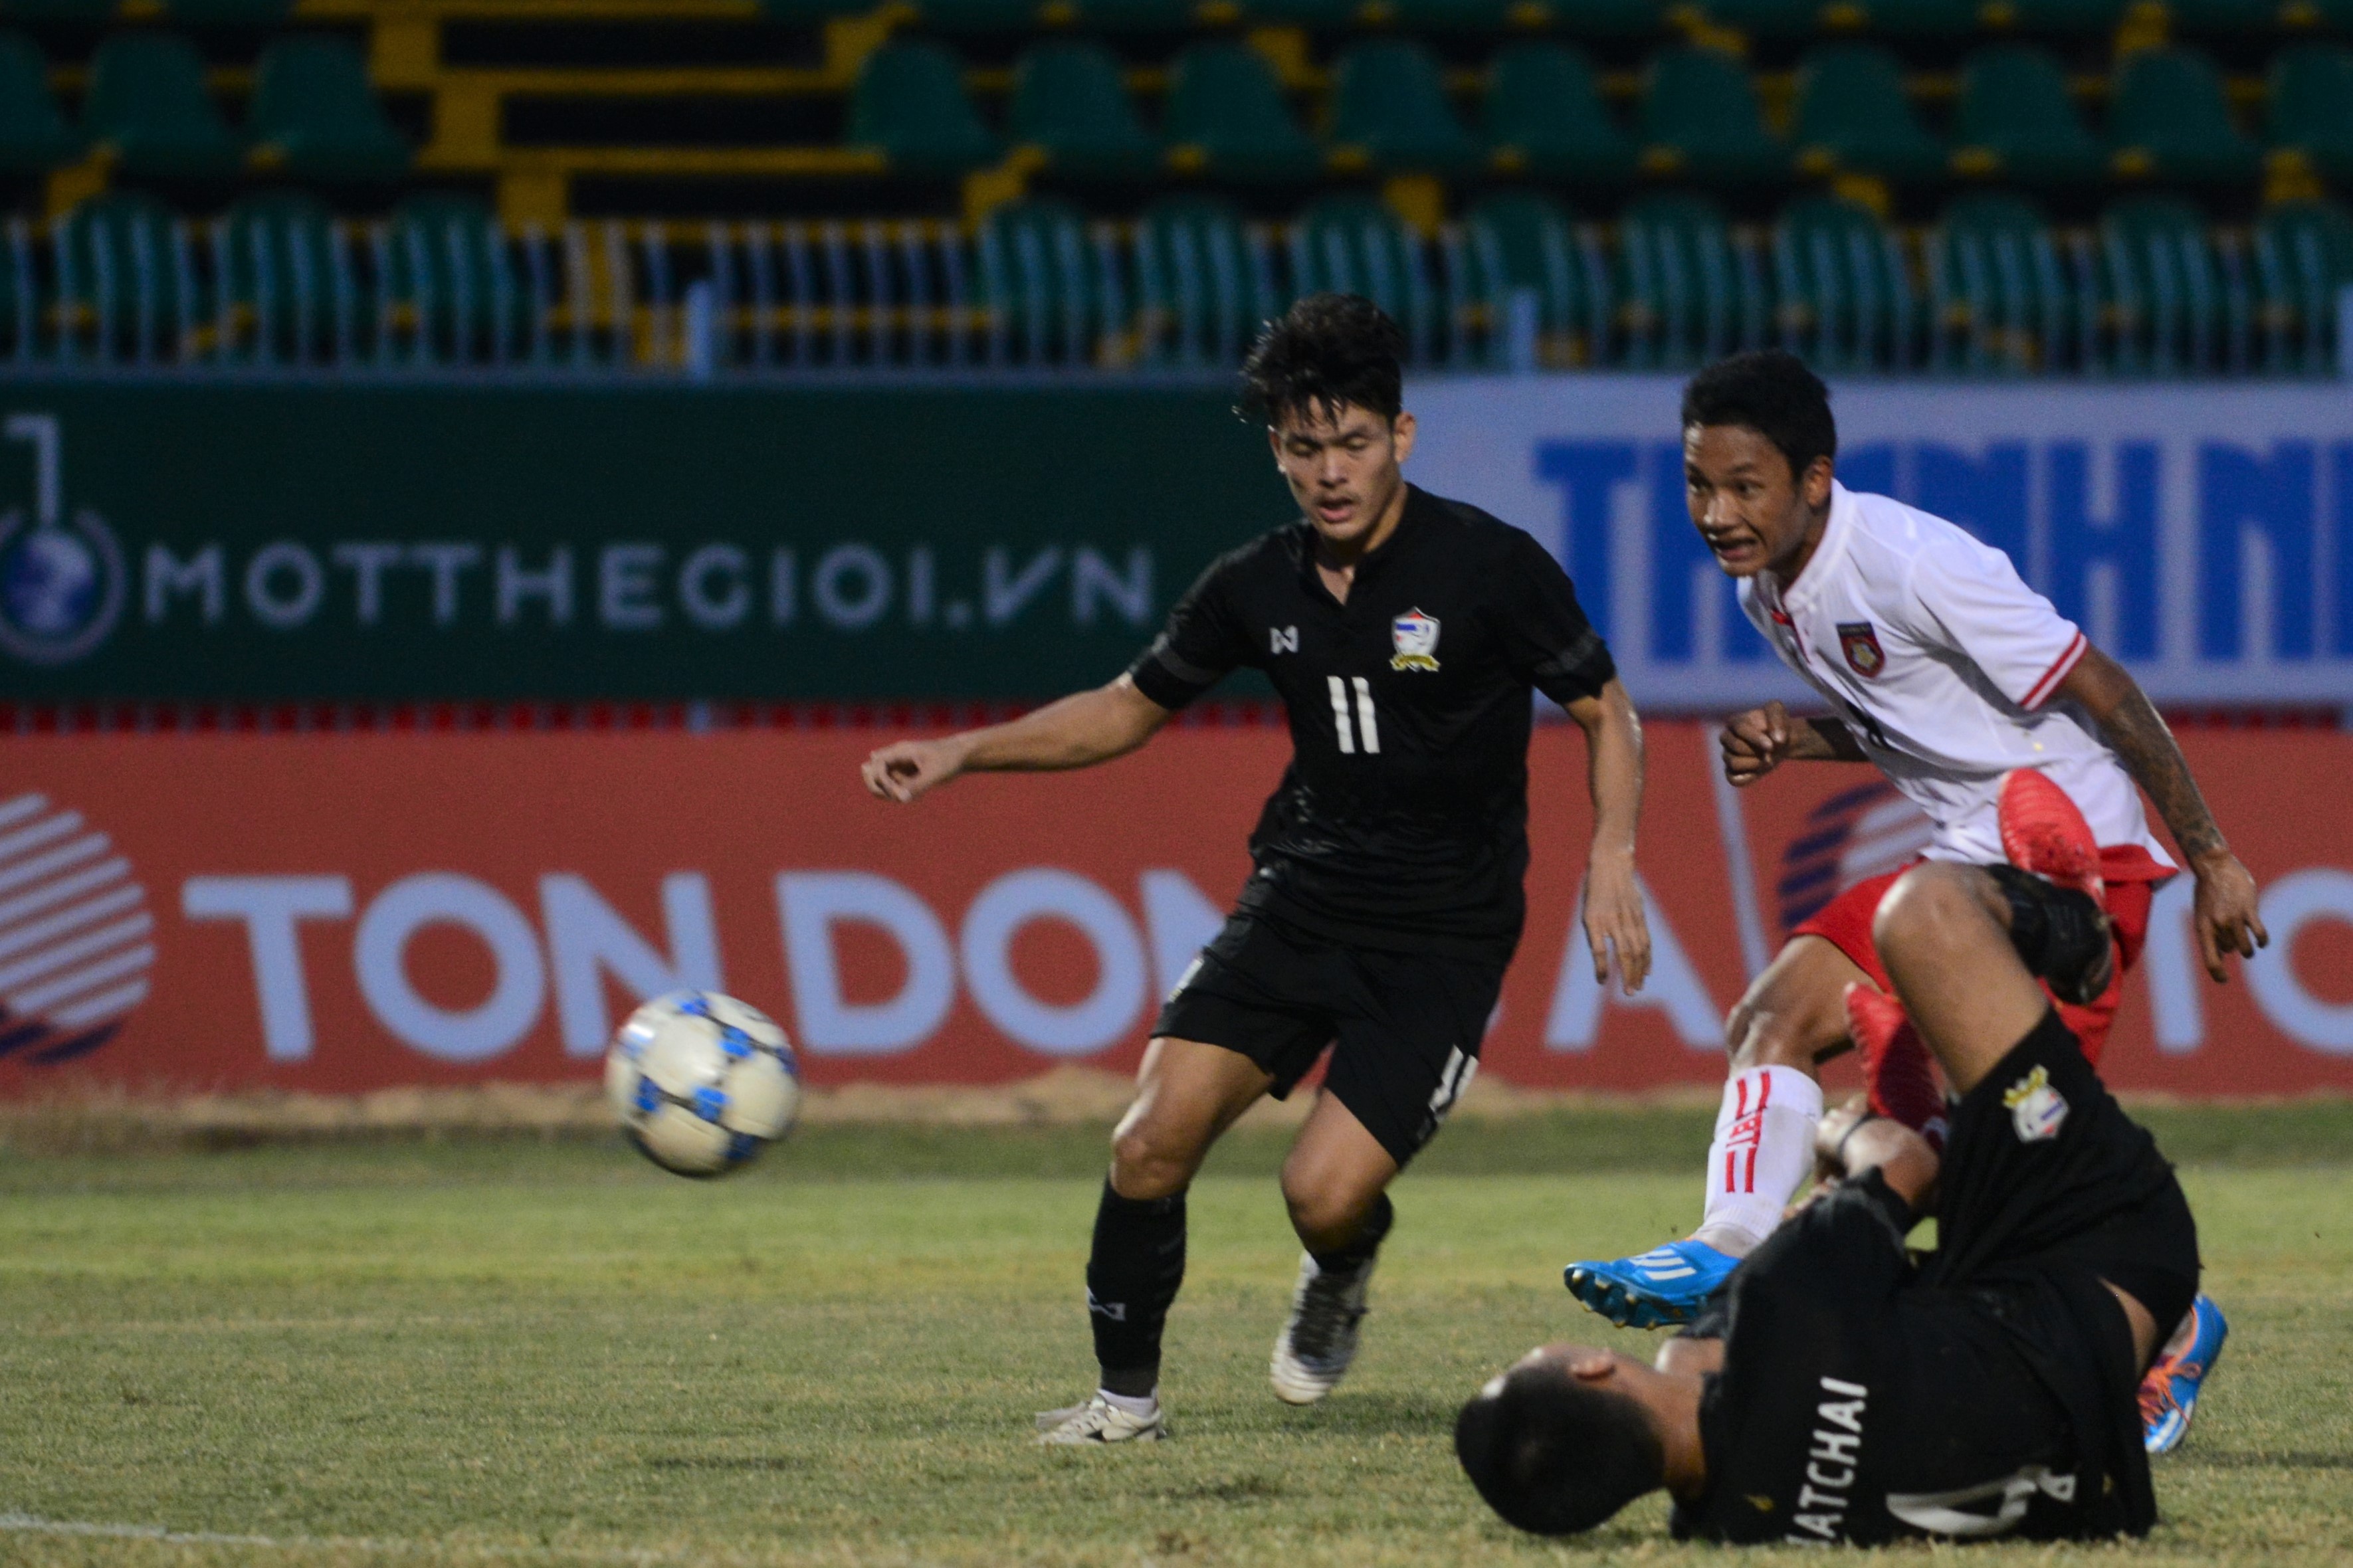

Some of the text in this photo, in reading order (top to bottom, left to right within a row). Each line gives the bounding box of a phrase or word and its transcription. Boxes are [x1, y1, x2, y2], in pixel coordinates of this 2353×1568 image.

[145, 539, 1155, 628] MOTTHEGIOI.VN
[1327, 676, 1381, 753] 11
[181, 869, 728, 1062] TON
